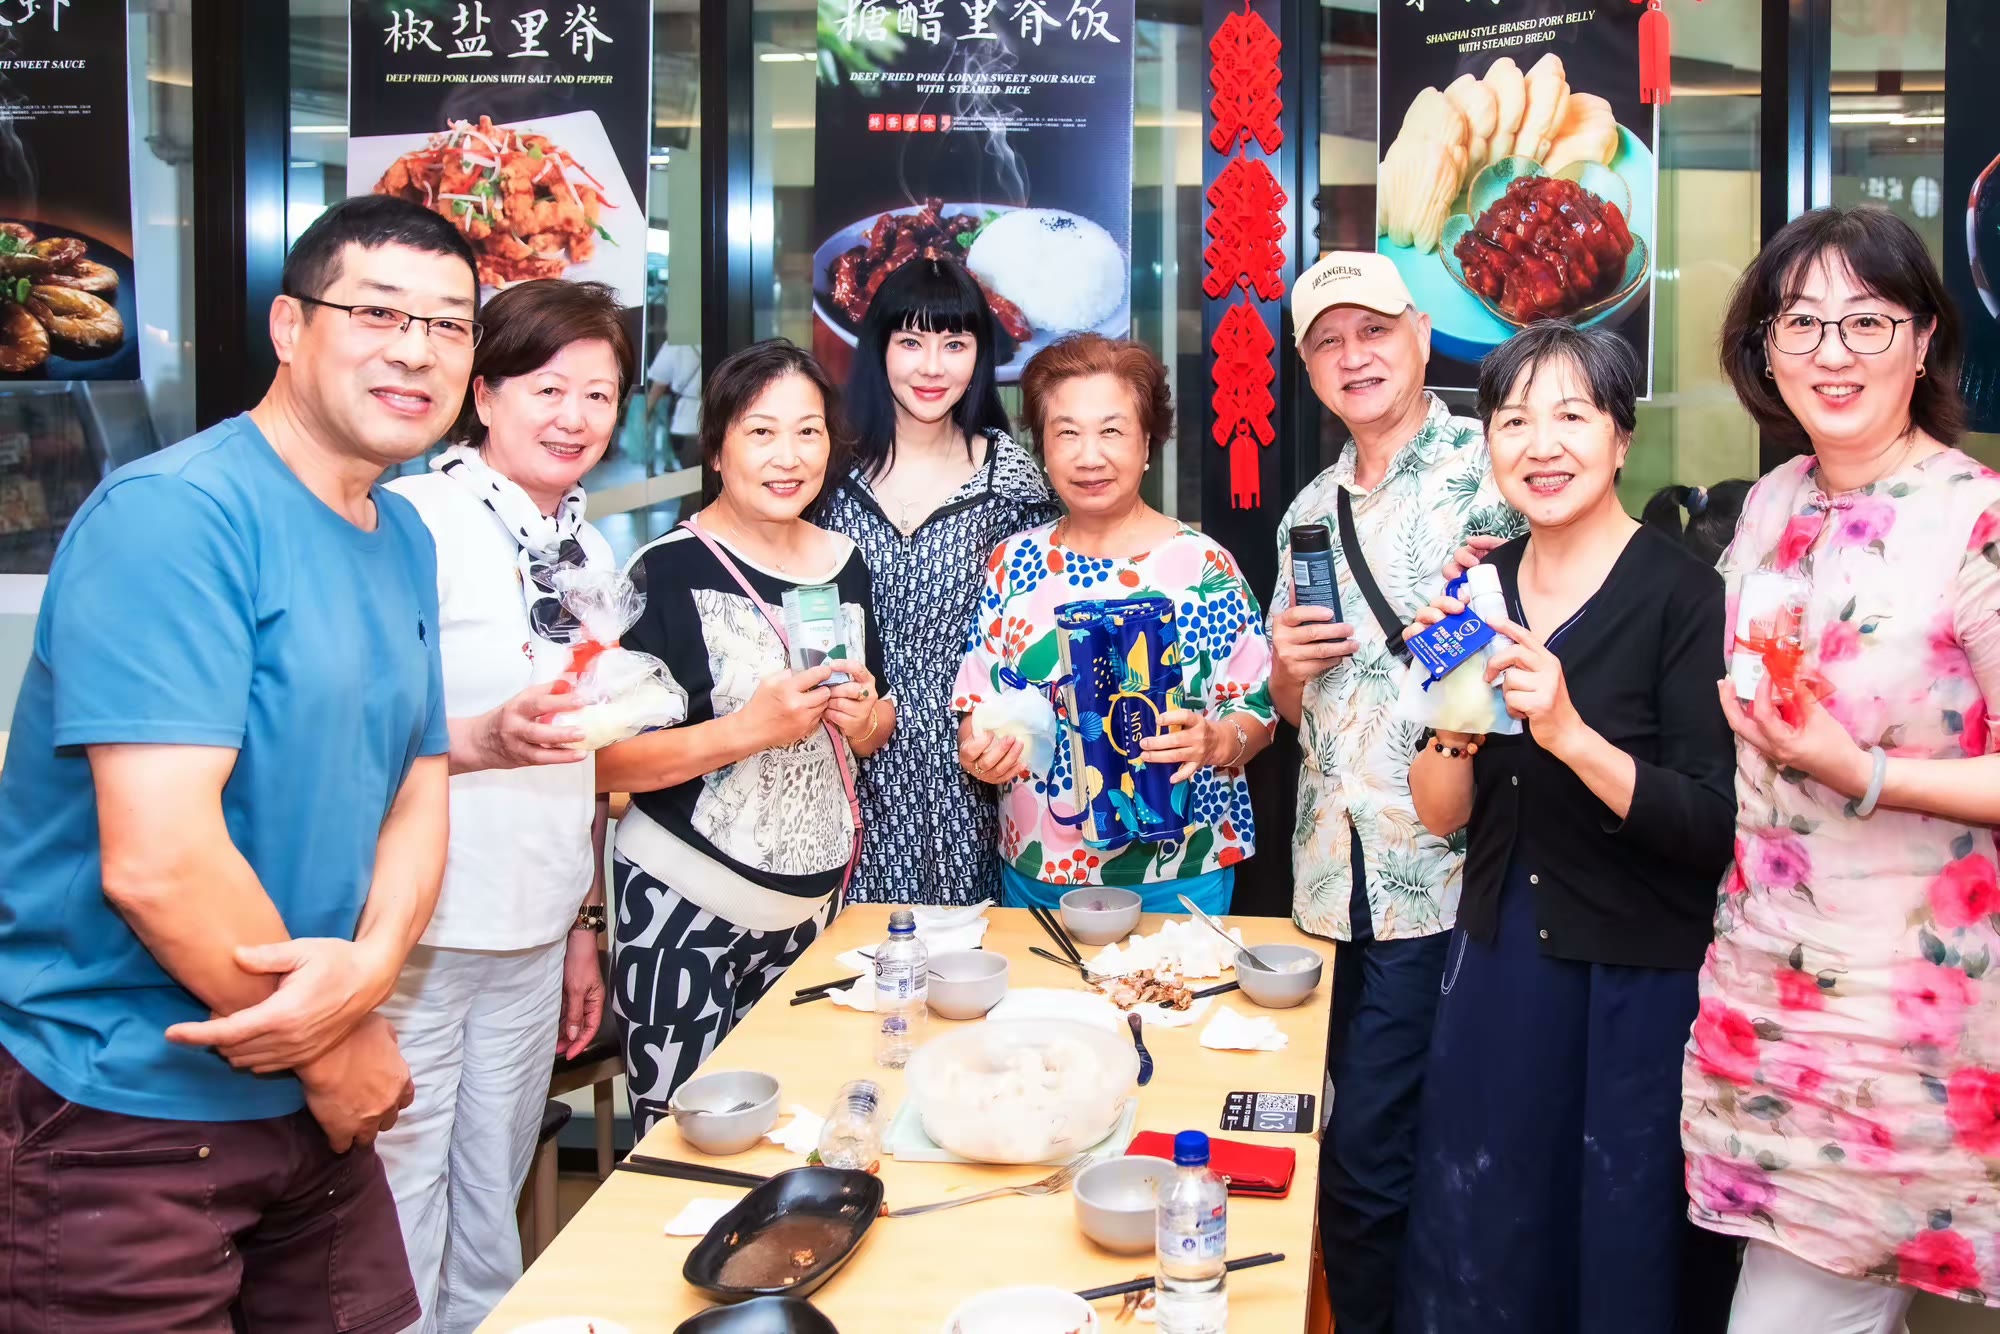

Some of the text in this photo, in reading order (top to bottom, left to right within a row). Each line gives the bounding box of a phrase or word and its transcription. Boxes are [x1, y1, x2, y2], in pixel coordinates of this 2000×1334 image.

[383, 0, 614, 62] 椒盐里脊
[834, 0, 1121, 46] 糖醋里脊饭
[1426, 10, 1596, 45] SHANGHAI STYLE BRAISED PORK BELLY
[1458, 30, 1556, 53] WITH STEAMED BREAD
[13, 60, 50, 69] SWEET
[51, 60, 86, 69] SAUCE
[385, 73, 614, 84] DEEP FRIED PORK LIONS WITH SALT AND PEPPER
[849, 72, 1097, 84] DEEP FRIED PORK LOIN IN SWEET SOUR SAUCE
[916, 84, 1031, 95] WITH STEAMED RICE
[1433, 643, 1446, 655] GIFT
[1130, 711, 1143, 742] SUN
[1259, 1112, 1286, 1130] 03
